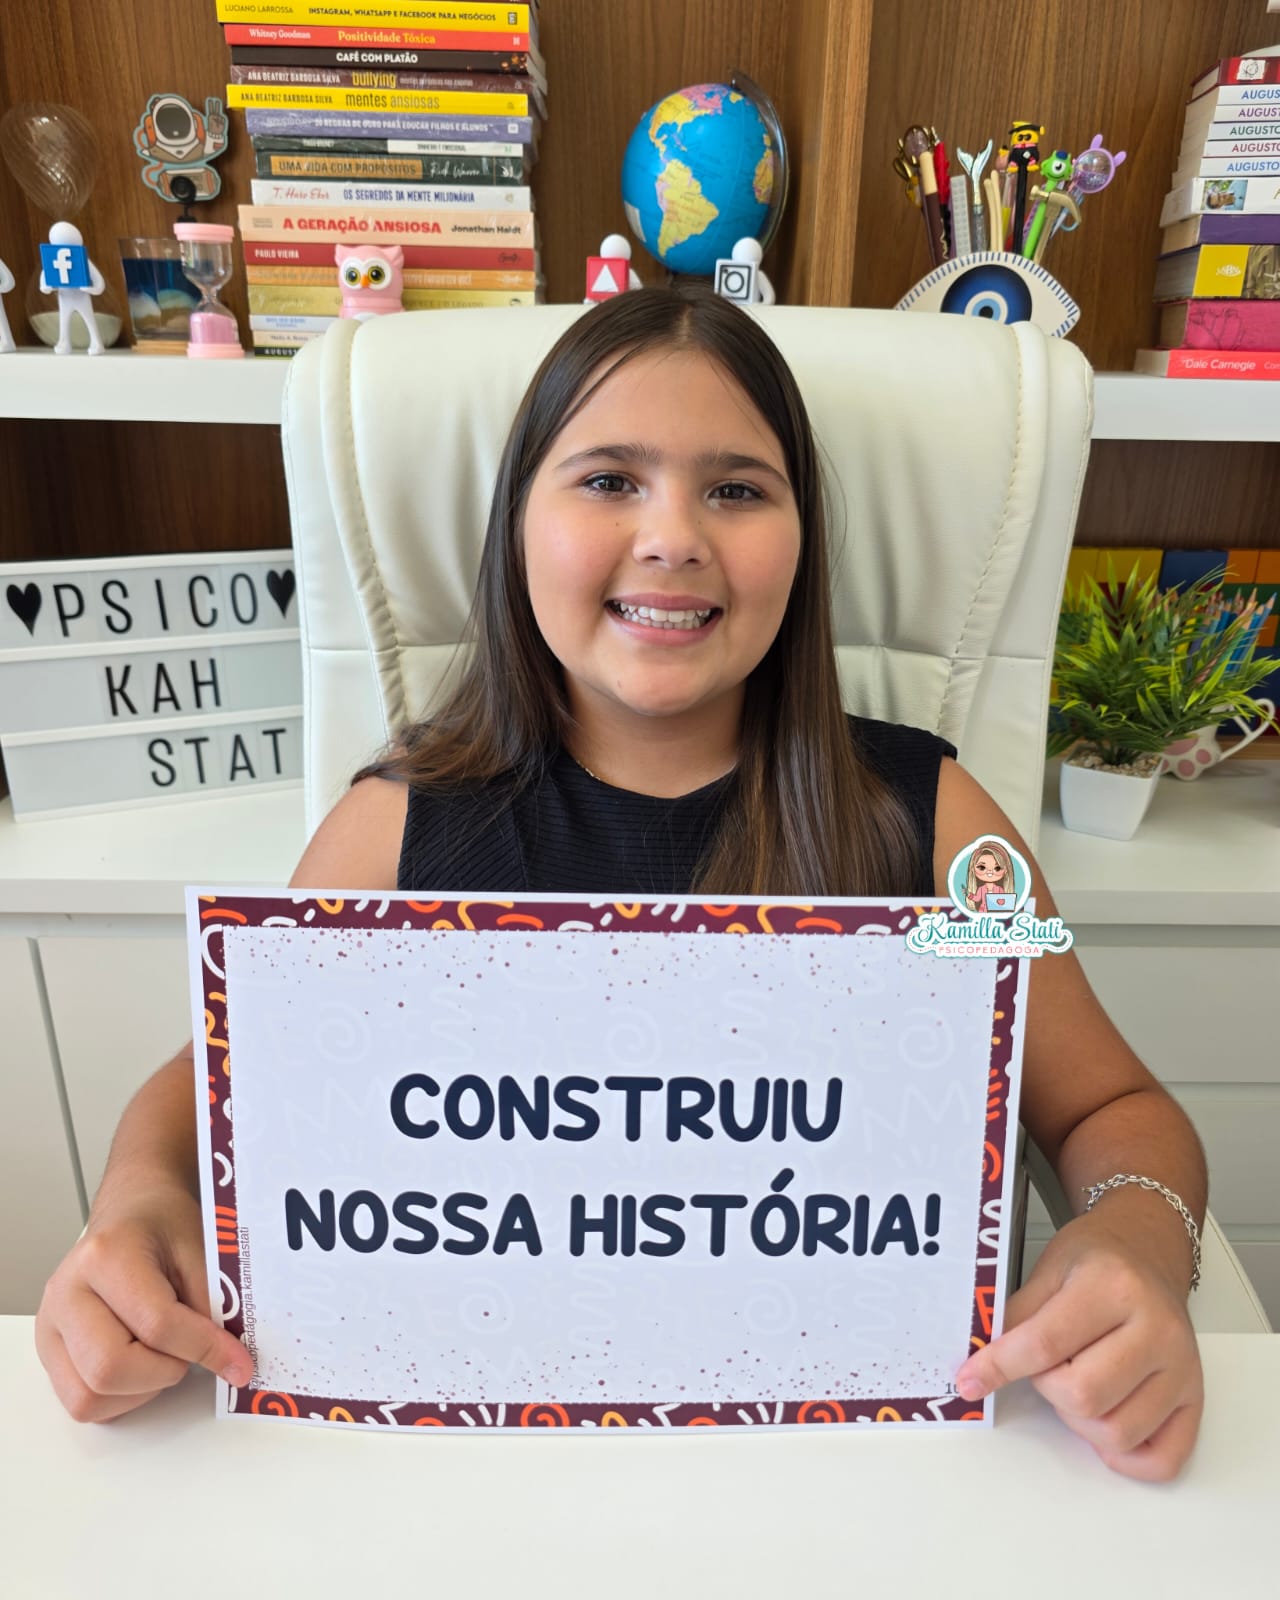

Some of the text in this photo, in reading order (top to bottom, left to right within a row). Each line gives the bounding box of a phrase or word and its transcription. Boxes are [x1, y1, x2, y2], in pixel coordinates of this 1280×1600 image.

[309, 8, 352, 16] INSTAGRAM,
[355, 9, 391, 17] WHATSAPP
[400, 11, 436, 19] FACEBOOK
[459, 11, 496, 21] NEGÓCIOS
[249, 28, 311, 40] Whitney Goodman
[338, 30, 436, 44] Positividade Tóxica
[336, 50, 418, 63] CAFÉ COM PLATÃO
[248, 71, 340, 83] ANA BEATRIZ BARBOSA SILVA
[352, 71, 397, 88] bullying
[241, 92, 333, 104] ANA BEATRIZ BARBOSA SILVA
[346, 92, 440, 109] mentes ansiosas
[1241, 89, 1280, 99] AUGUS
[402, 121, 429, 130] EDUCAR
[430, 122, 455, 131] FILHOS
[1229, 125, 1280, 135] AUGUSTO
[279, 161, 302, 171] UMA
[304, 161, 327, 172] VIDA
[330, 162, 352, 173] COM
[1227, 161, 1280, 172] AUGUSTO
[343, 189, 475, 203] OS SEGREDOS DA MENTE MILIONÁRIA
[283, 217, 294, 230] A
[297, 216, 369, 234] GERAÇÃO
[373, 219, 442, 234] ANSIOSA
[451, 225, 495, 234] Jonathan
[255, 249, 300, 259] PAULO VIEIRA
[1185, 358, 1209, 369] Dale
[1210, 359, 1256, 372] Carnegie
[53, 573, 258, 638] PSICO
[105, 658, 221, 717] KAH
[147, 728, 287, 787] STAT
[390, 1073, 843, 1143] CONSTRUIU
[285, 1167, 942, 1257] NOSSA HISTÓRIA!
